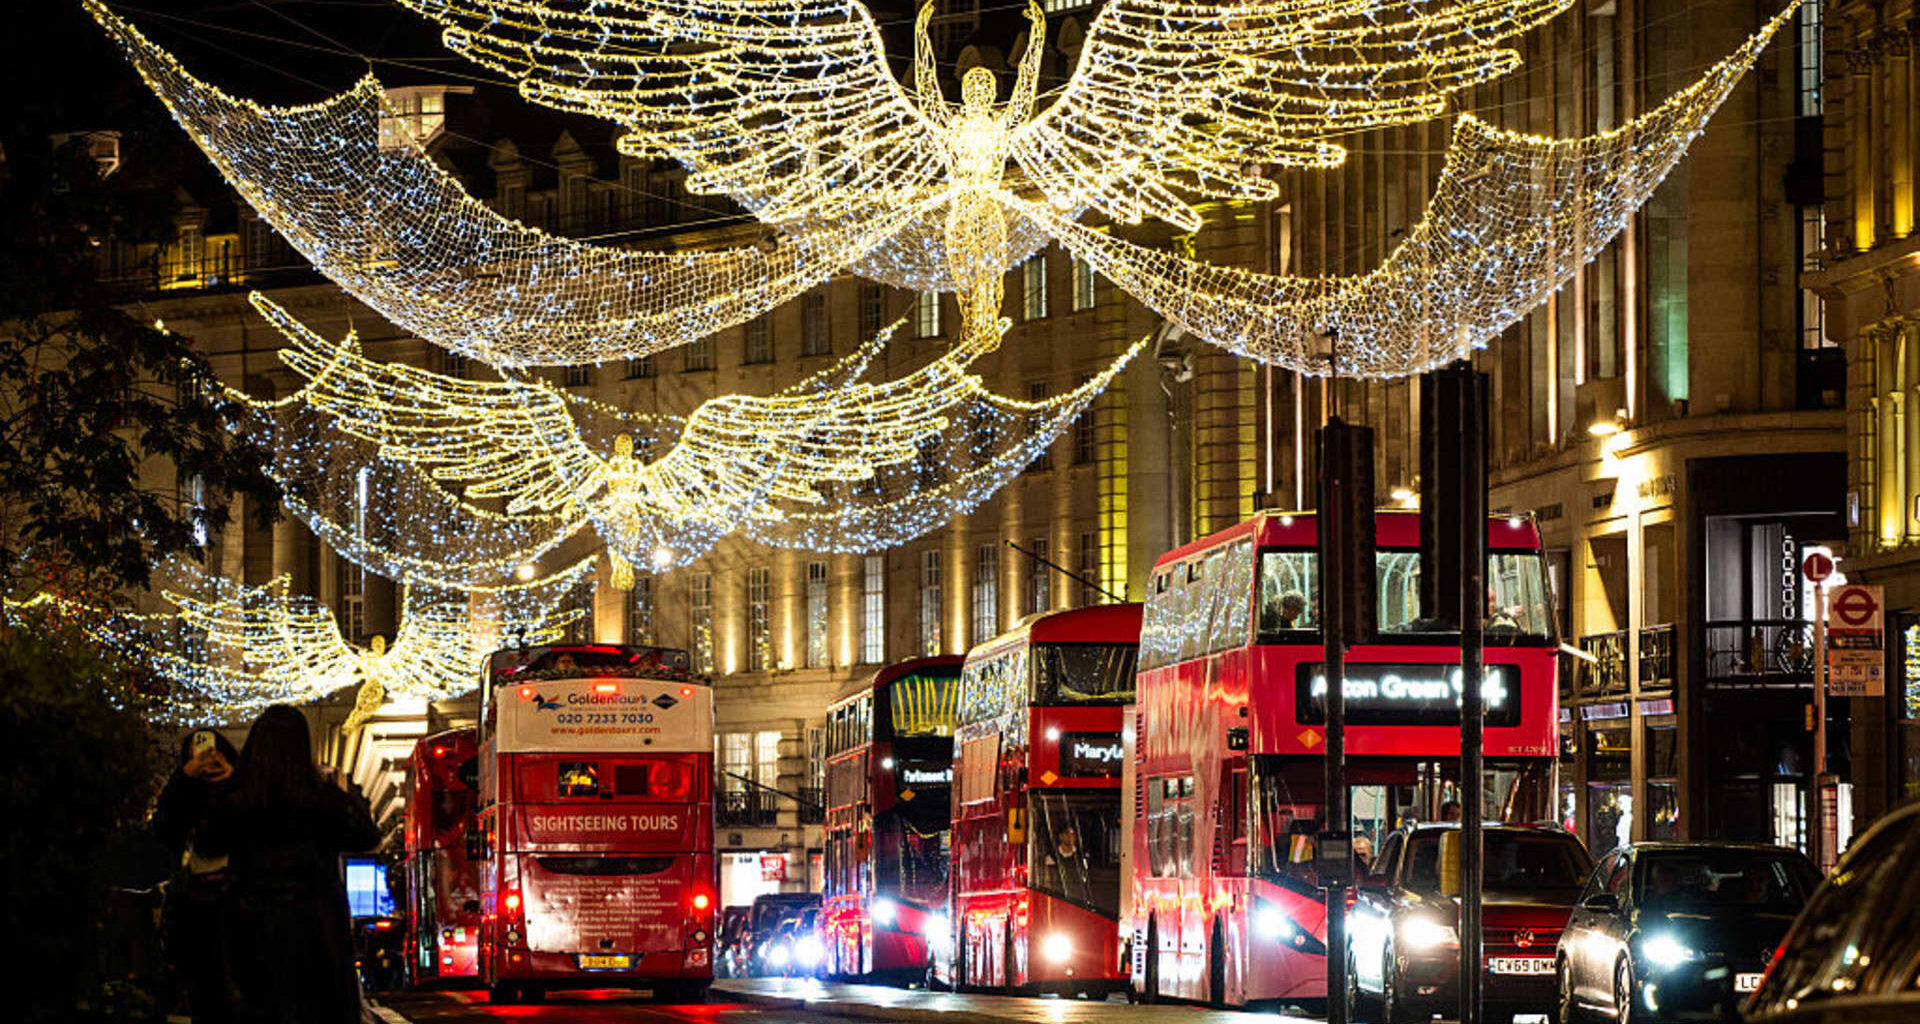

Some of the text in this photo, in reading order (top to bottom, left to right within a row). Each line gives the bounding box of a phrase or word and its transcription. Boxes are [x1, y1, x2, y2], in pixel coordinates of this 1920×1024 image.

[1813, 556, 1826, 578] L
[1310, 675, 1378, 698] Aton
[1380, 674, 1449, 698] Green
[557, 713, 653, 724] 020 7233 7030
[551, 726, 661, 736] www.goldentours.com
[533, 815, 678, 832] SIGHTSEEING TOURS
